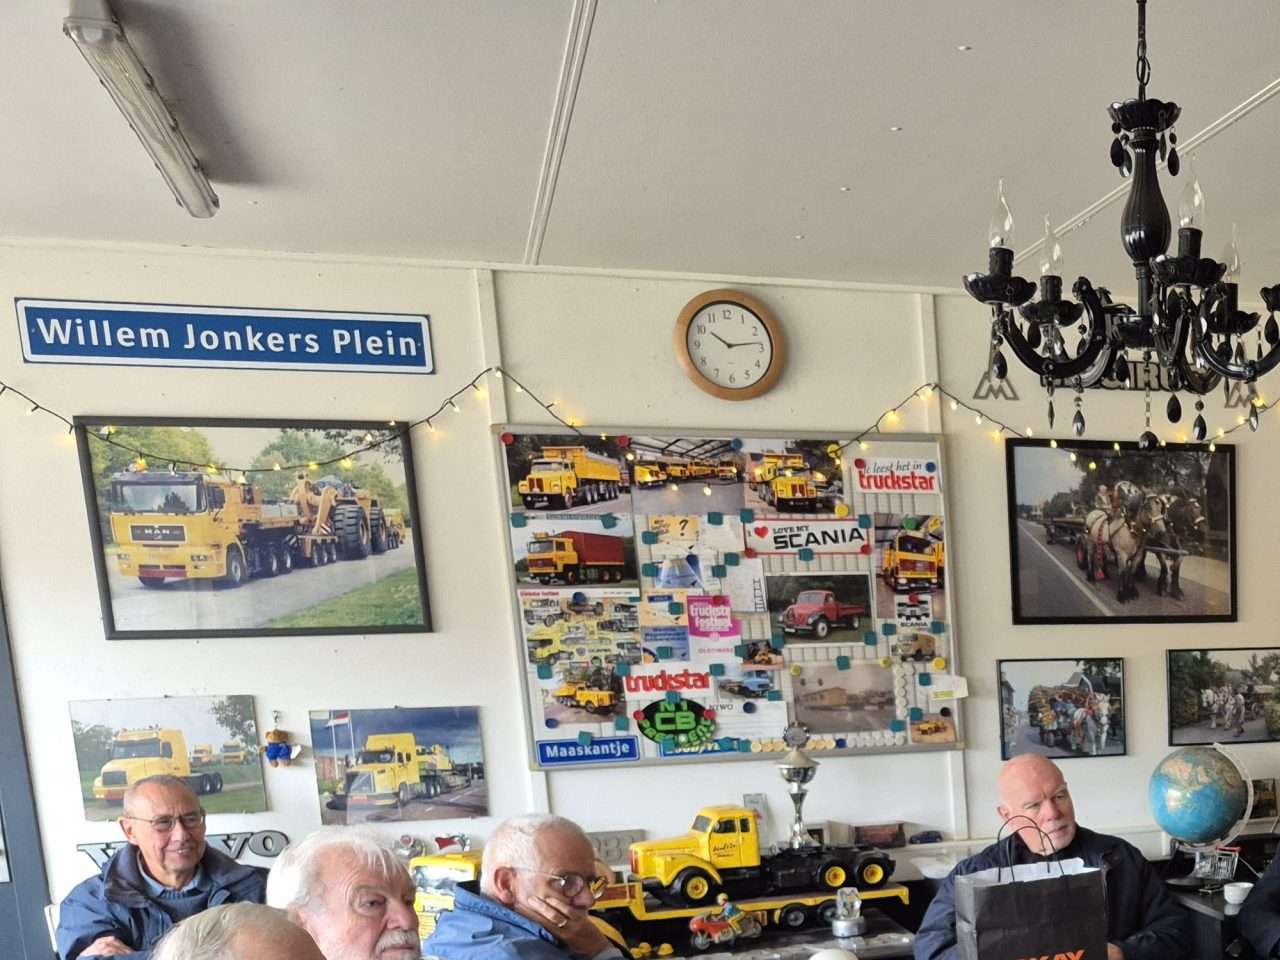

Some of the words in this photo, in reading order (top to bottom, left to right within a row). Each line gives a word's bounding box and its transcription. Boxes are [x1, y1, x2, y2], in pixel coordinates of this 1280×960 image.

[708, 312, 716, 323] 11
[721, 309, 732, 320] 12
[36, 317, 171, 348] Willem
[184, 323, 321, 354] Jonkers
[334, 328, 419, 357] Plein
[752, 326, 759, 336] 2
[729, 373, 736, 384] 6
[858, 470, 935, 490] truckstar
[773, 527, 865, 550] SCANIA
[625, 669, 710, 693] truckstar
[655, 711, 697, 731] CB
[545, 741, 630, 758] Maaskantje
[77, 829, 290, 878] VVO
